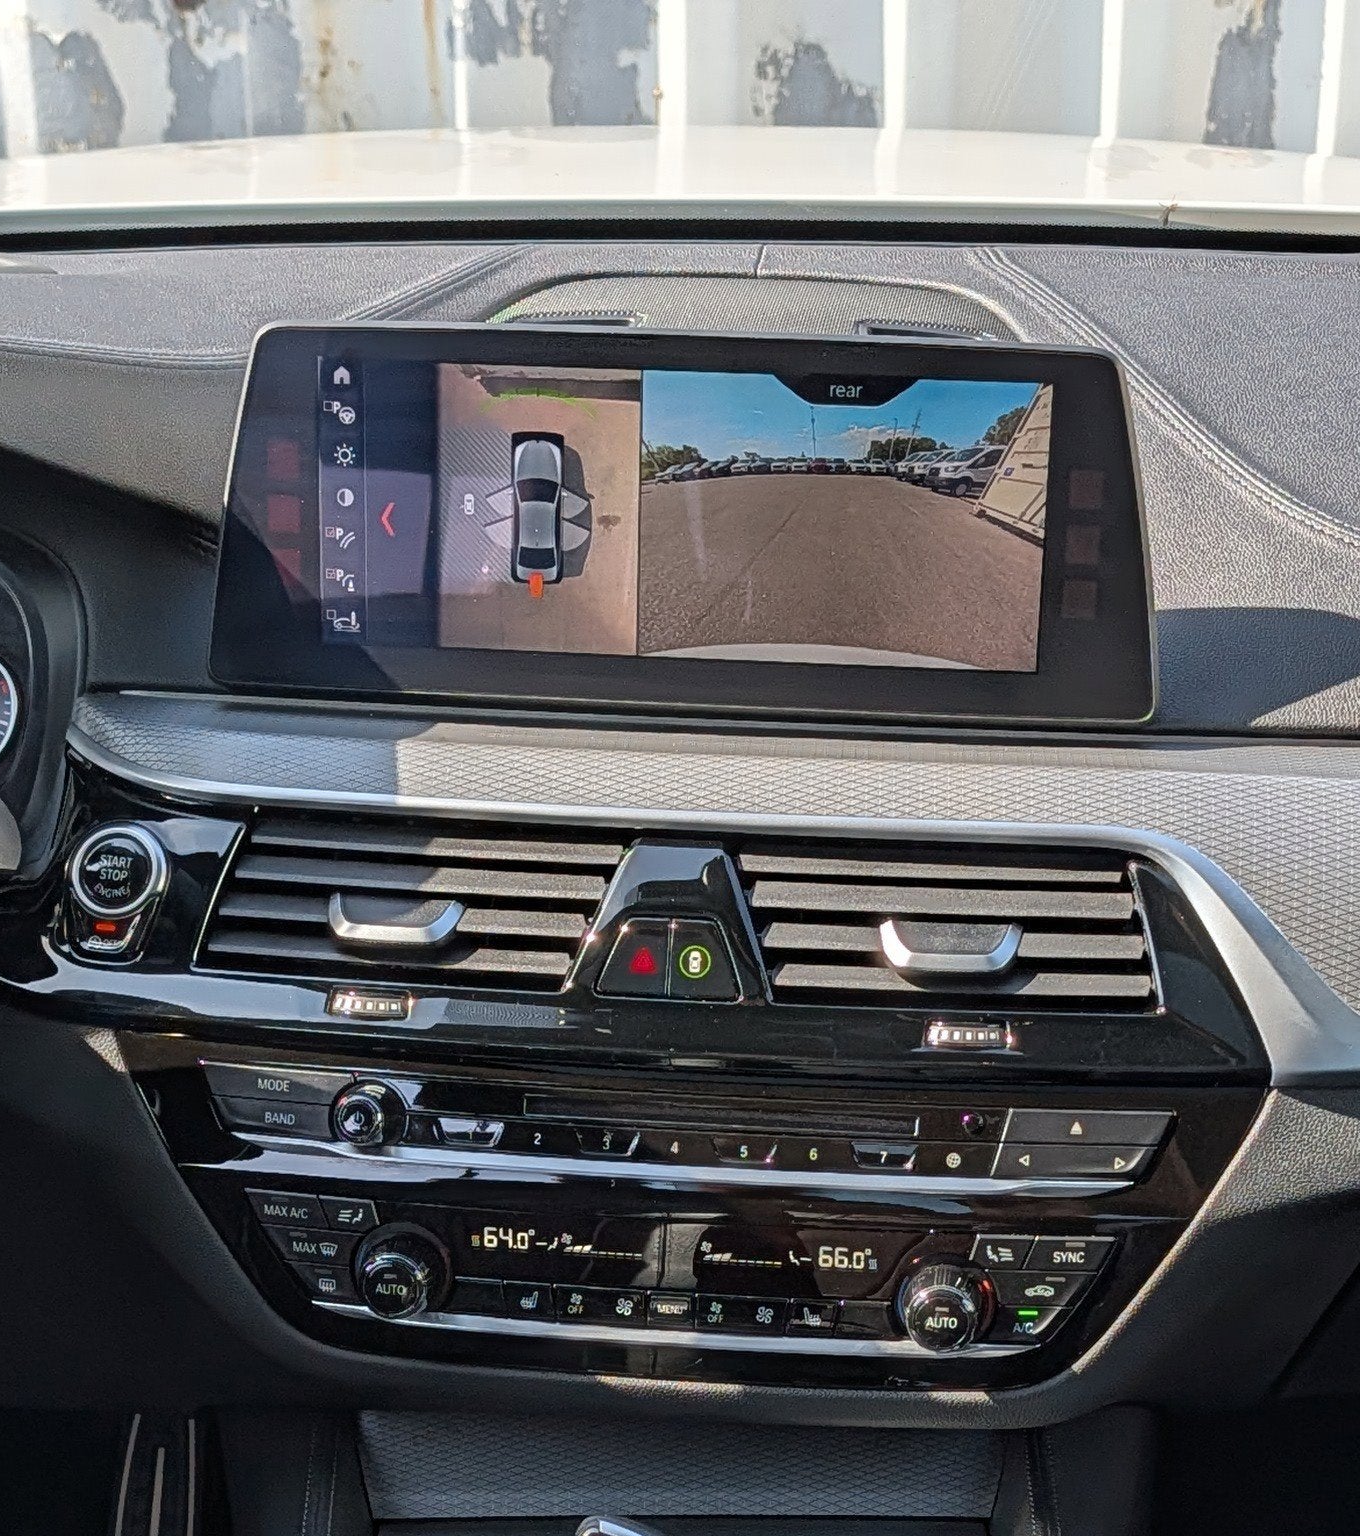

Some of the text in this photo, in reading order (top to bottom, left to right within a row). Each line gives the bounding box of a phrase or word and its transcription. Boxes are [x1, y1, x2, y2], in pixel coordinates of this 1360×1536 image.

[829, 381, 863, 398] rear
[99, 854, 134, 869] START
[99, 868, 129, 882] STOP
[257, 1077, 291, 1093] MODE
[264, 1111, 296, 1126] BAND
[533, 1132, 542, 1146] 2
[602, 1138, 610, 1150] 3
[670, 1140, 680, 1155] 4
[740, 1145, 749, 1158] 5
[809, 1147, 818, 1161] 6
[880, 1150, 889, 1164] 7
[263, 1203, 309, 1220] MAX A/C
[292, 1240, 318, 1255] MAX
[1052, 1251, 1085, 1264] SYNC
[375, 1282, 407, 1296] AUTO
[567, 1304, 584, 1315] OFF
[706, 1313, 725, 1324] OFF
[924, 1315, 958, 1330] AUTO
[1012, 1321, 1034, 1334] A/C
